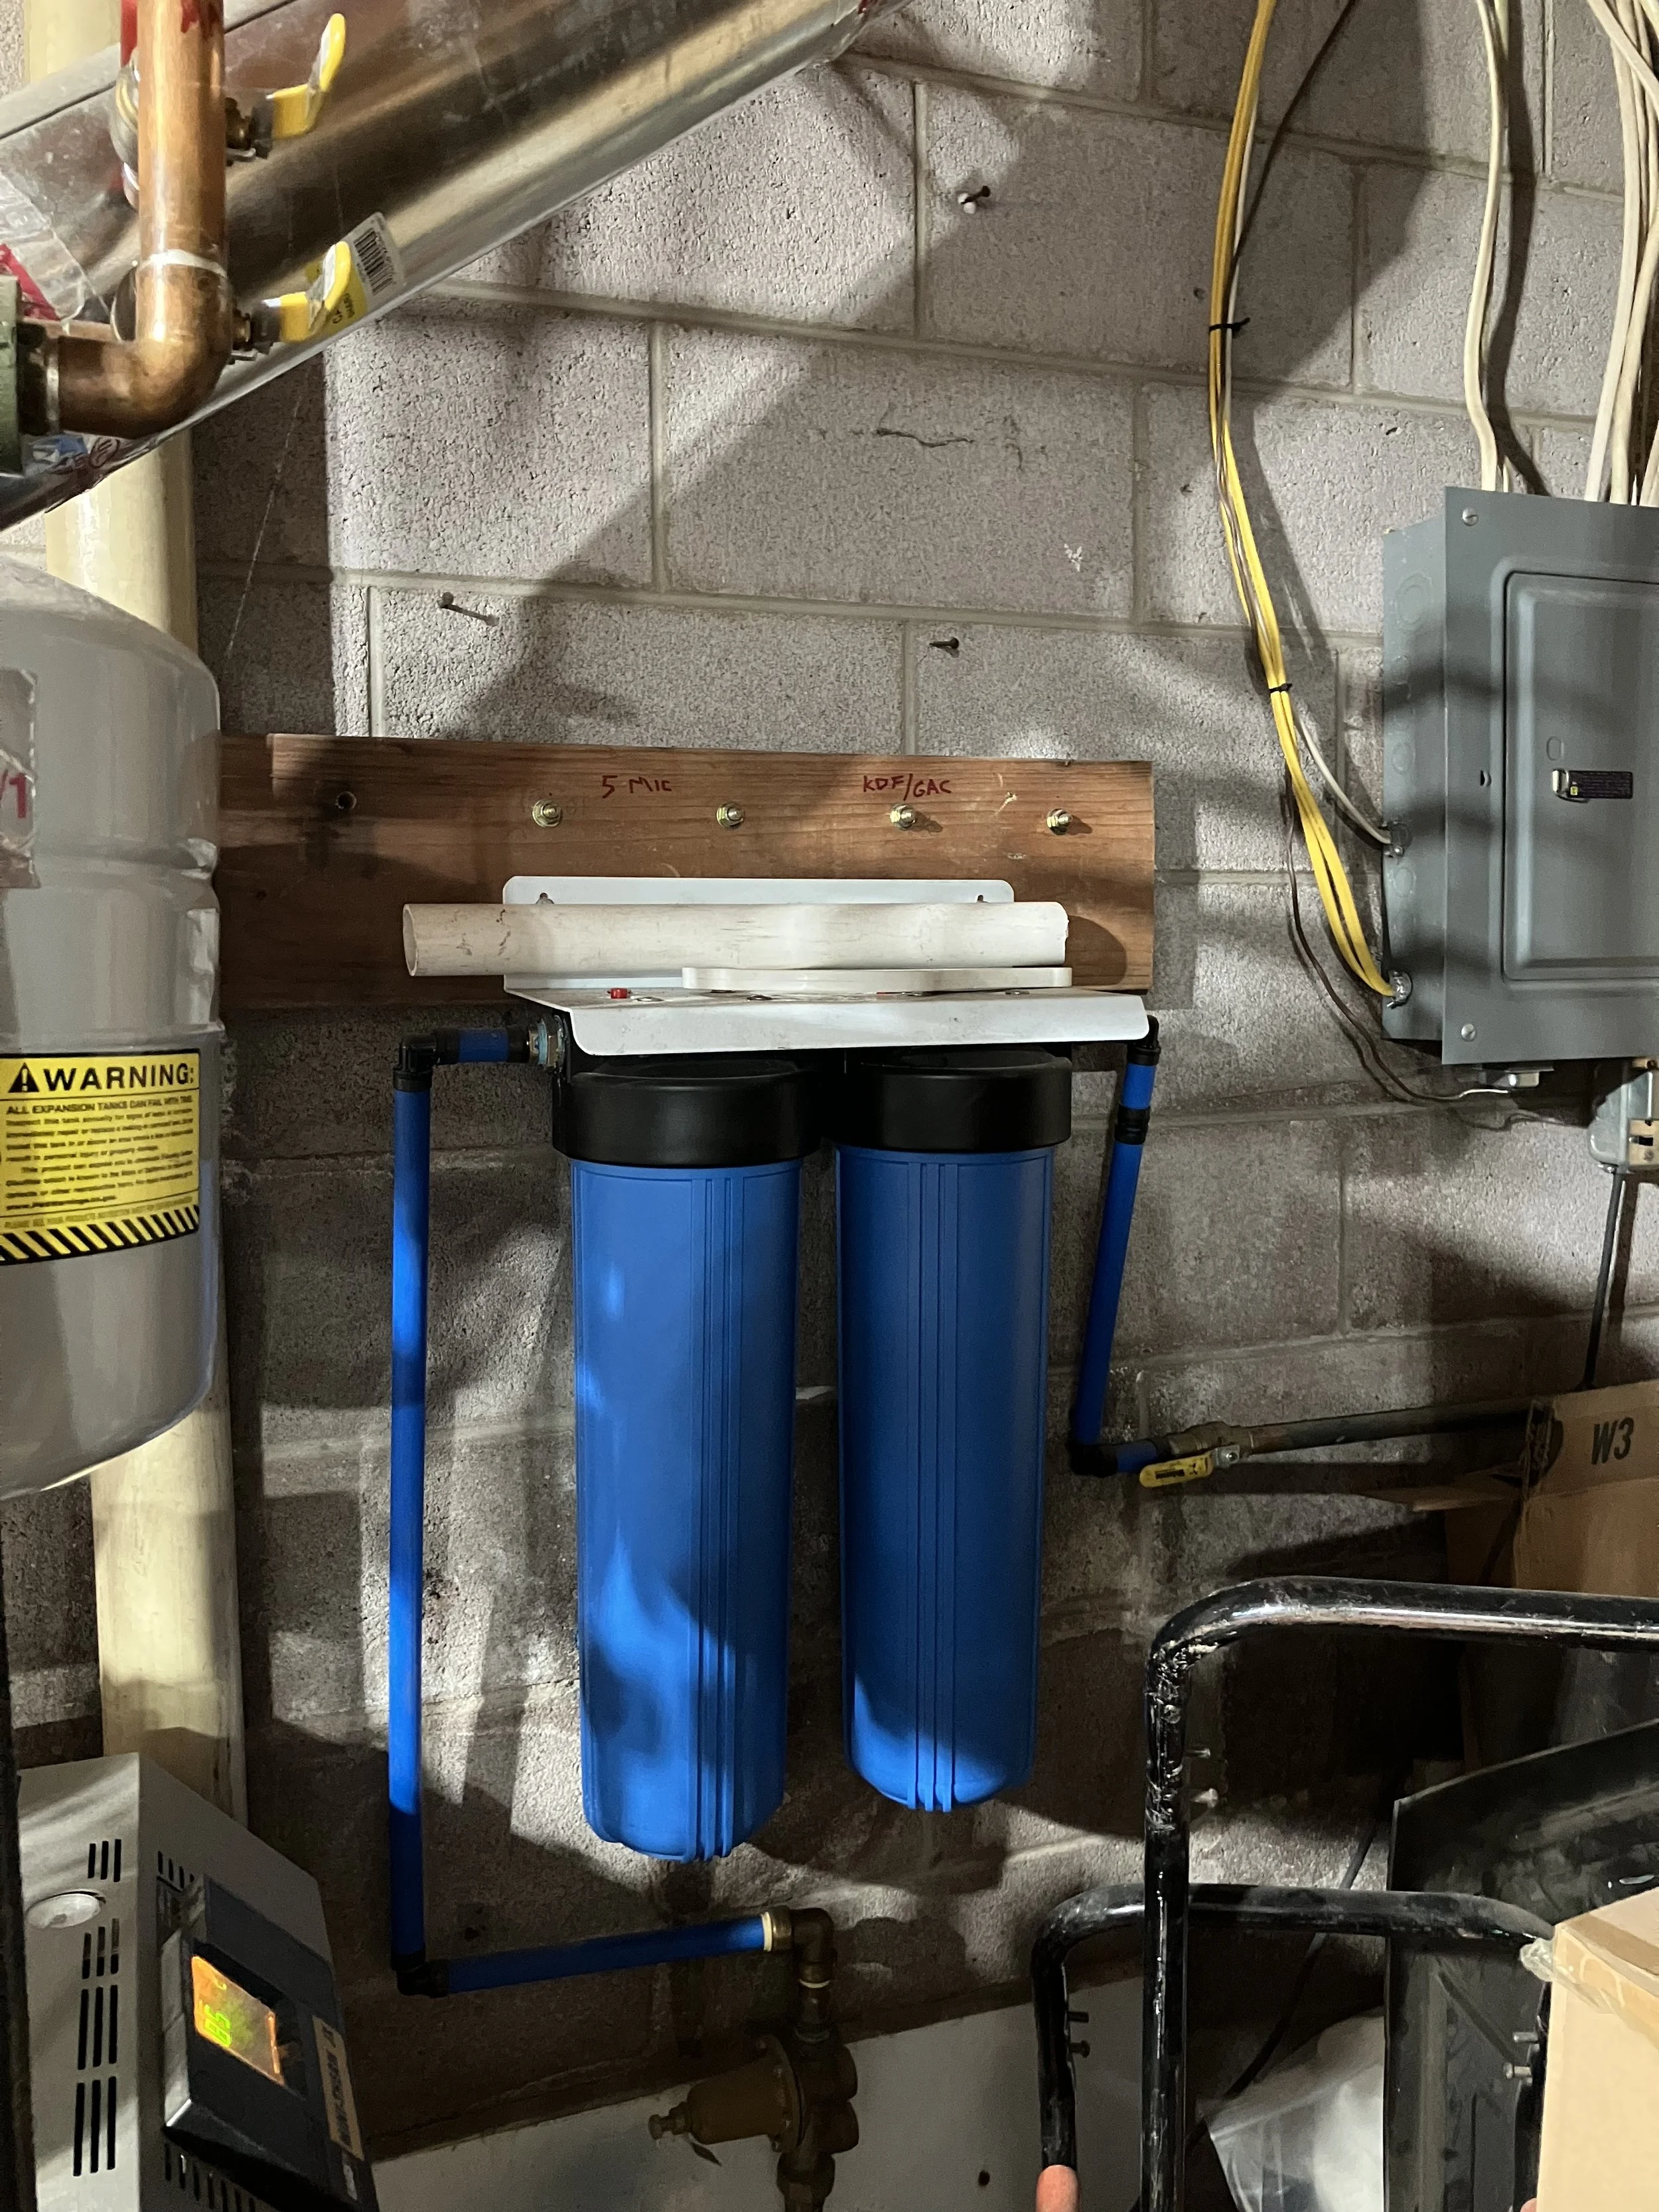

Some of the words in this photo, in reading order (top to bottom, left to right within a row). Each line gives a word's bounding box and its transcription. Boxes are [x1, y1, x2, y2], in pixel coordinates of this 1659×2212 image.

[602, 774, 618, 798] 5
[628, 776, 672, 794] MIC
[863, 773, 952, 801] KDF/GAC
[43, 1063, 194, 1092] WARNING:
[6, 1106, 29, 1115] ALL
[32, 1103, 95, 1114] EXPANSION
[1591, 1417, 1634, 1465] W3
